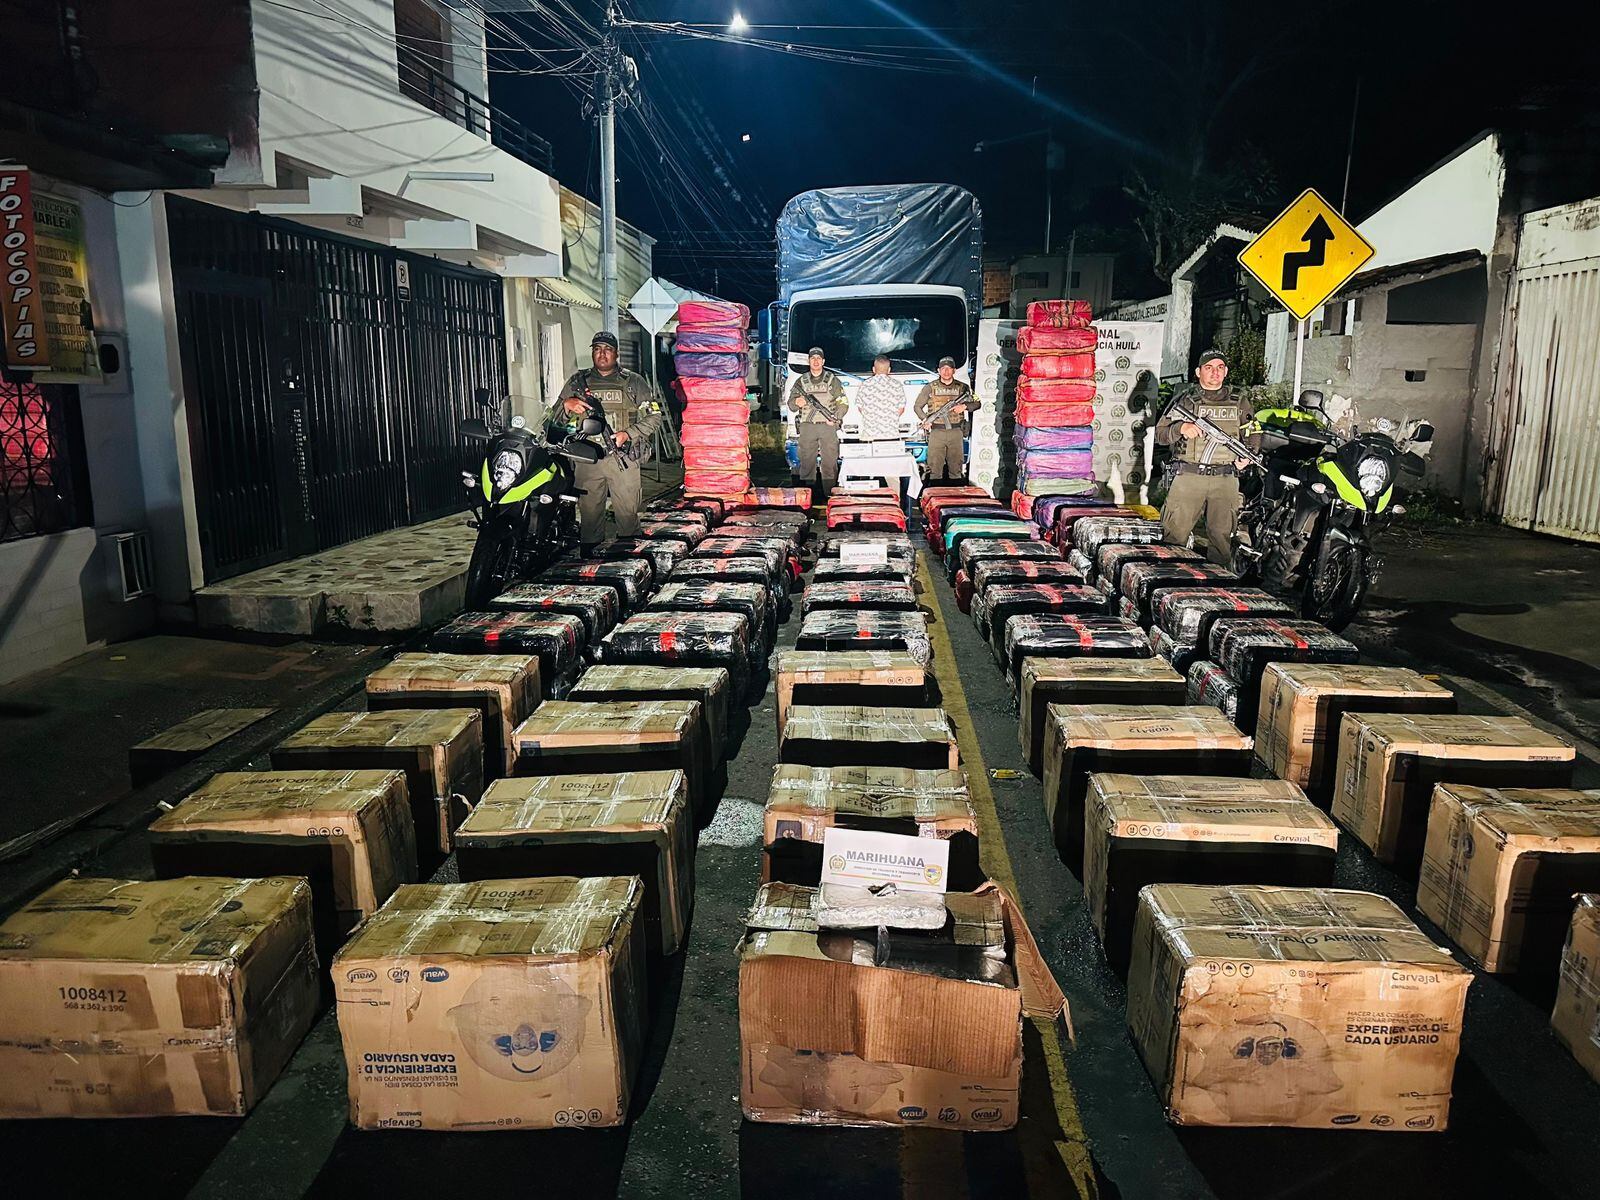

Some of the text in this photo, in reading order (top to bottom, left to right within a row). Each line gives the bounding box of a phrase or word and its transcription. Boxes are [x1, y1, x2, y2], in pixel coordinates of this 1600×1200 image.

[0, 176, 37, 357] FOTOCOPIAS
[1099, 329, 1120, 339] NAL
[1000, 339, 1018, 349] DEP
[1115, 341, 1141, 350] HUILA
[593, 391, 621, 401] OLICIA
[1200, 408, 1235, 418] POLICIA
[1274, 834, 1310, 843] Carvajal
[846, 850, 925, 868] MARIHUANA
[482, 888, 544, 898] 1008412
[1392, 972, 1441, 984] Carvajal
[59, 987, 128, 1003] 1008412
[64, 1001, 79, 1009] 568
[108, 1004, 125, 1012] 390
[1345, 1034, 1439, 1045] CADA USUARIO
[364, 1053, 455, 1063] CADA USUARIO
[376, 1064, 457, 1074] EXPERIENCIA
[378, 1117, 422, 1128] Carvajal
